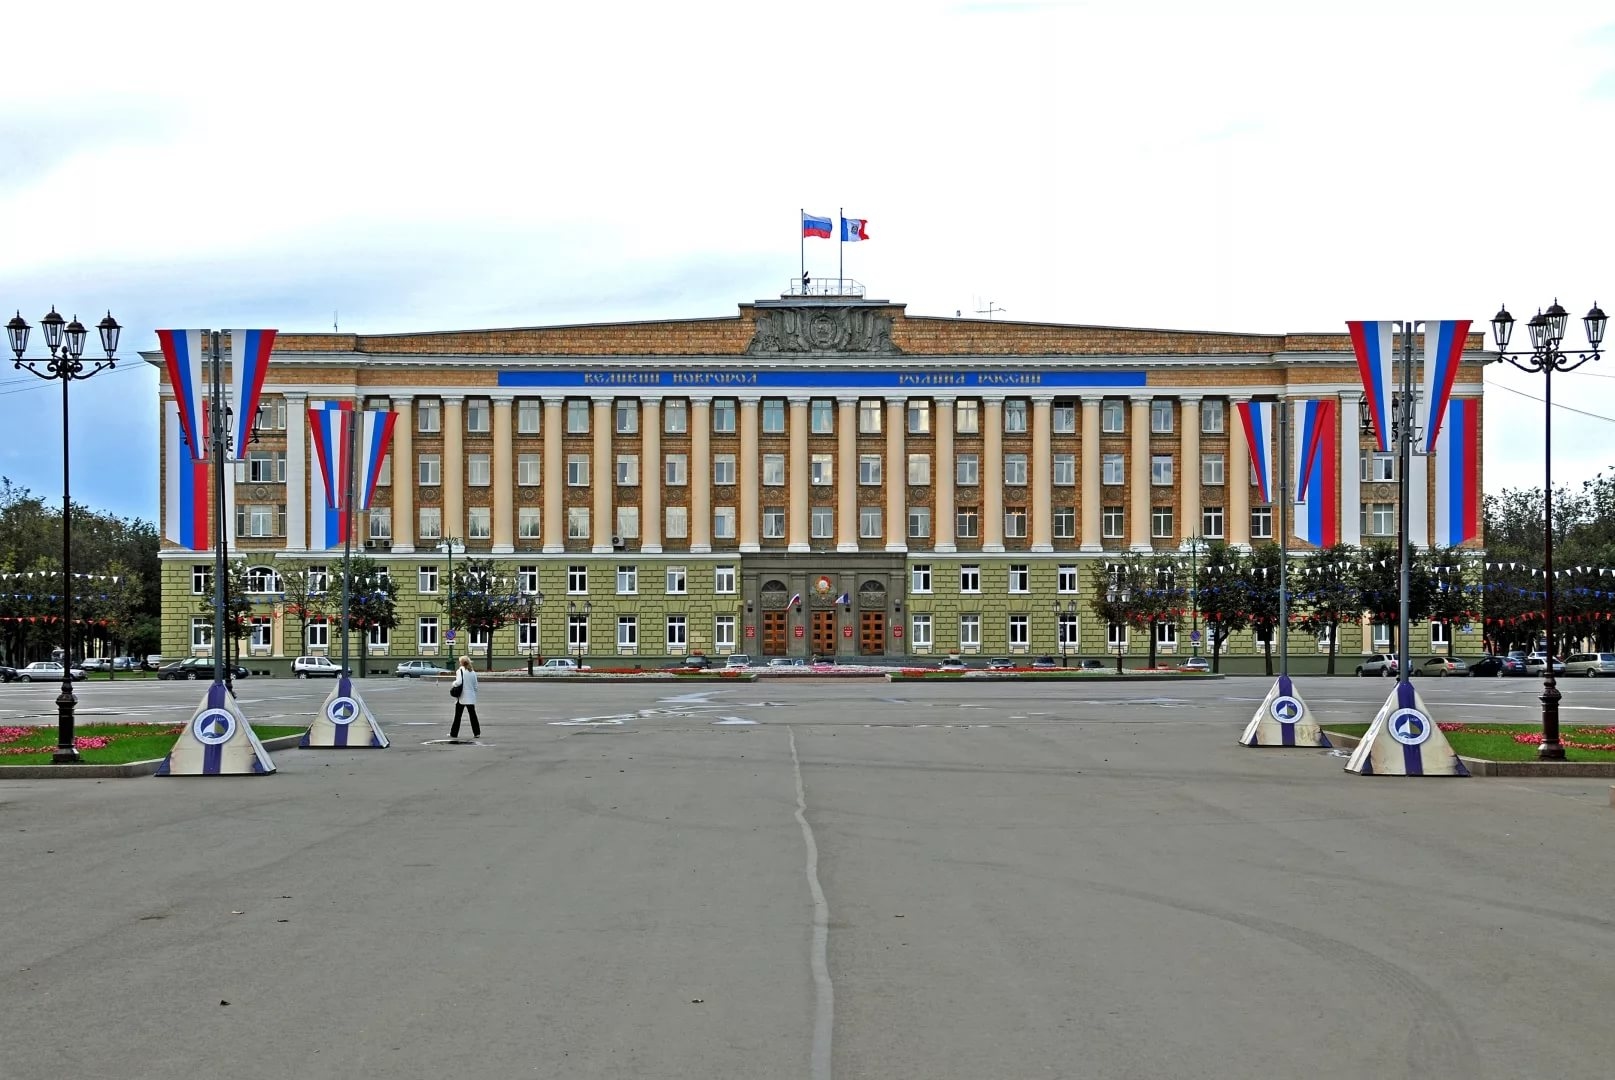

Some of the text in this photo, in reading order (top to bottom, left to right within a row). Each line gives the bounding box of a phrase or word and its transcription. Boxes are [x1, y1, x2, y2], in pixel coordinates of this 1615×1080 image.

[673, 373, 757, 384] НОВГОРОД
[899, 374, 965, 384] РОДИНА
[978, 374, 1041, 384] РОССИИ
